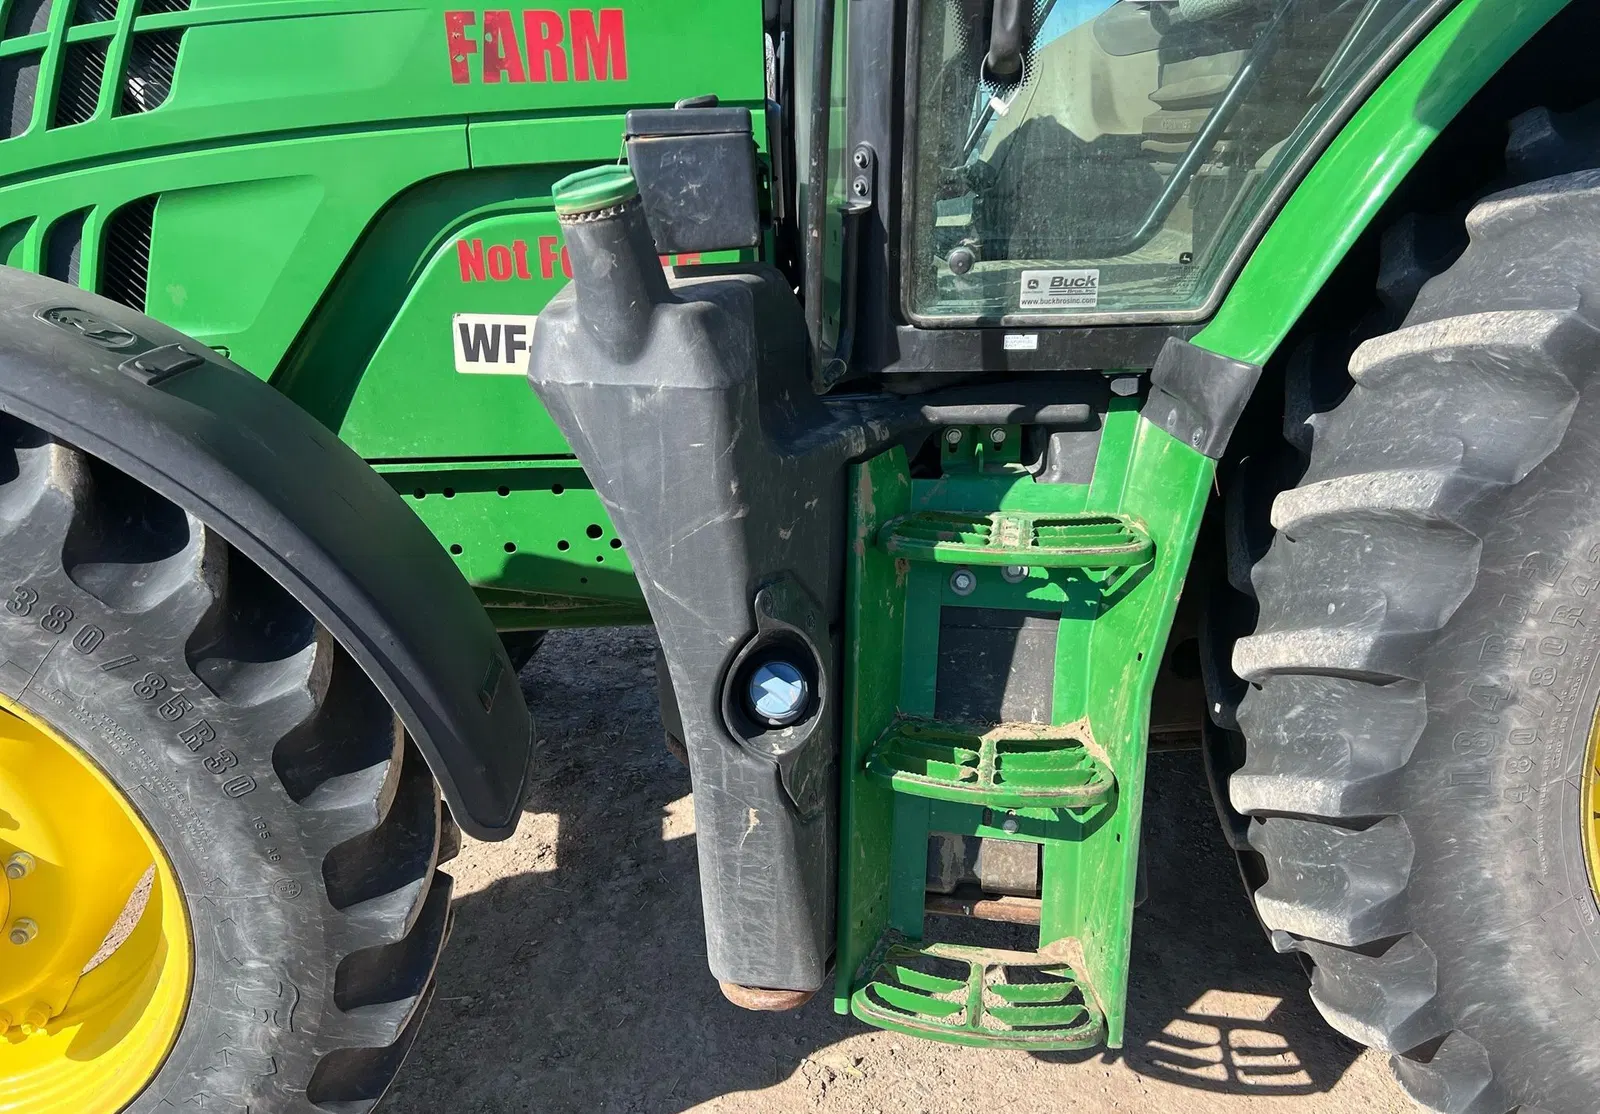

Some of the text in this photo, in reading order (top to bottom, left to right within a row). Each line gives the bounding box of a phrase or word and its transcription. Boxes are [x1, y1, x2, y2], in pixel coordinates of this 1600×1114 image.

[444, 8, 629, 85] FARM
[457, 238, 532, 283] Not
[1050, 275, 1097, 287] Buck
[4, 585, 257, 799] 380/85R30
